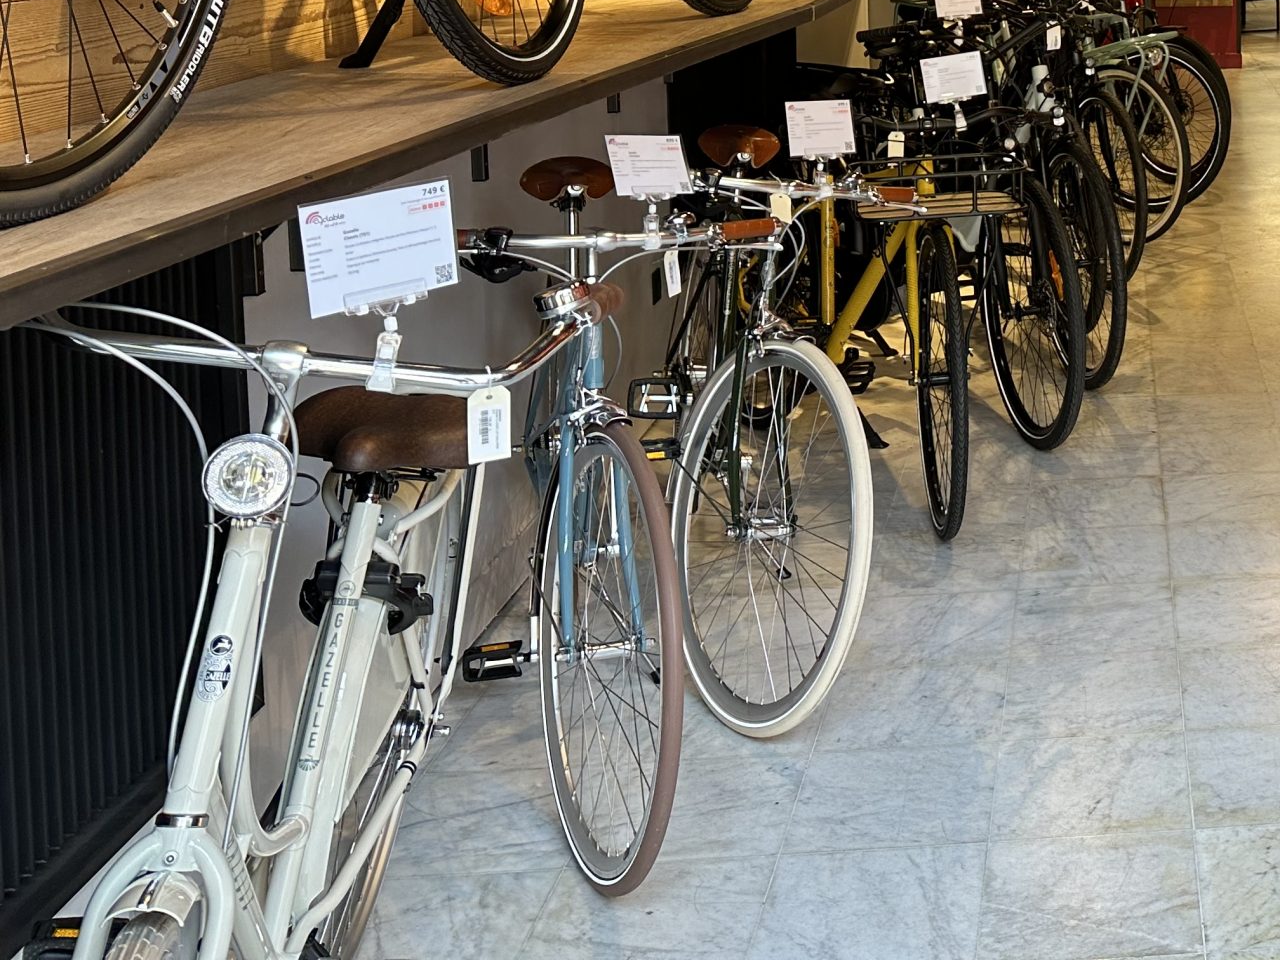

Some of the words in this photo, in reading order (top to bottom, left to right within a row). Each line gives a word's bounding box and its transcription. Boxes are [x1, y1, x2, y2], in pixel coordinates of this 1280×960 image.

[178, 44, 208, 91] RIDDLER
[421, 186, 437, 196] 749
[439, 185, 446, 193] €
[307, 612, 345, 749] GAZELLE
